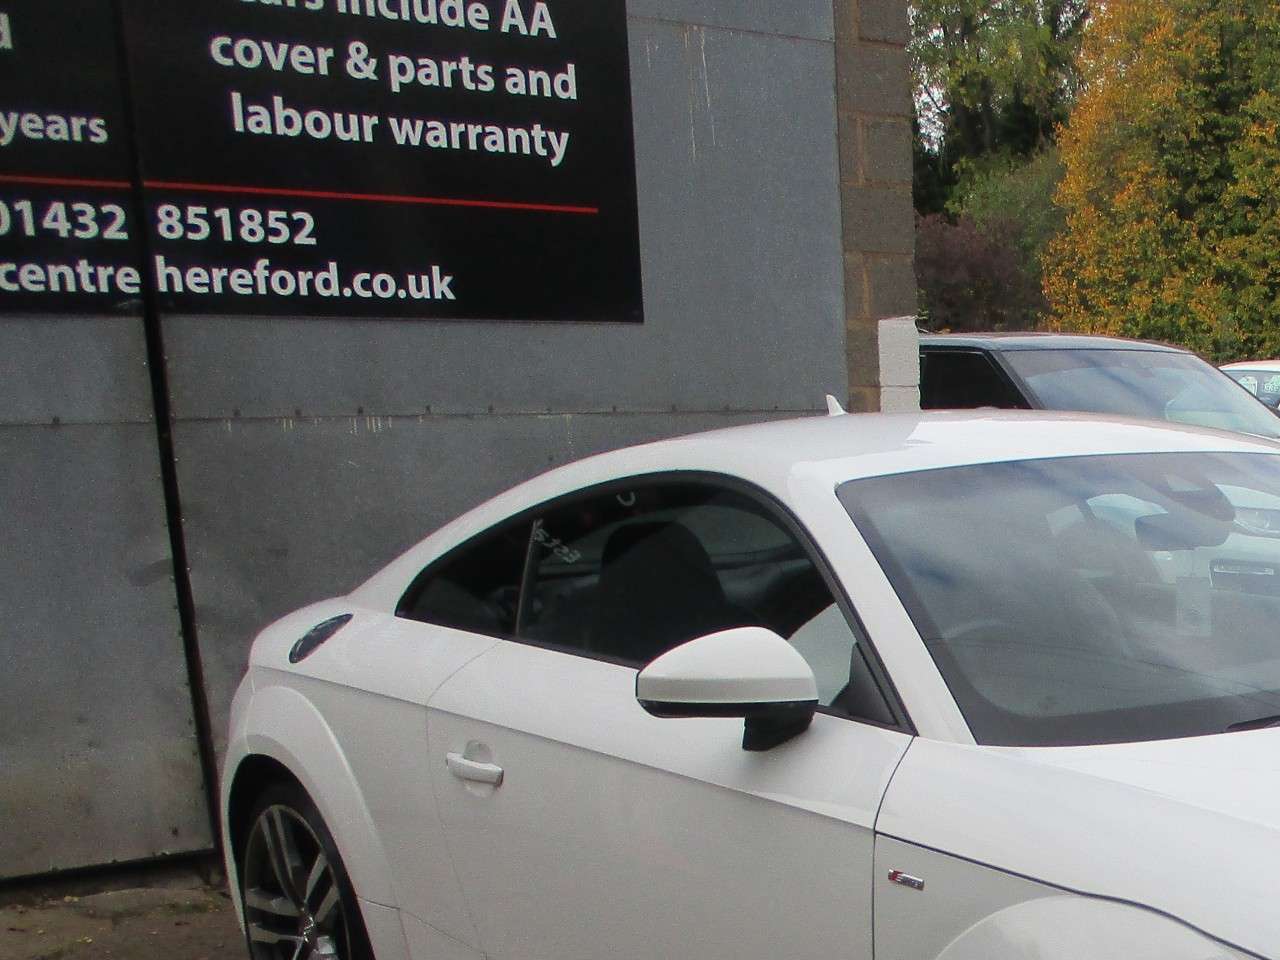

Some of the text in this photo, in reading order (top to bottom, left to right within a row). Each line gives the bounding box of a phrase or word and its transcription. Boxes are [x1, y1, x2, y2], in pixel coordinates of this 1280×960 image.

[501, 0, 557, 39] AA
[210, 35, 577, 101] cover & parts and
[230, 91, 569, 167] labour warranty
[156, 204, 317, 246] 851852
[155, 255, 456, 300] hereford.co.uk
